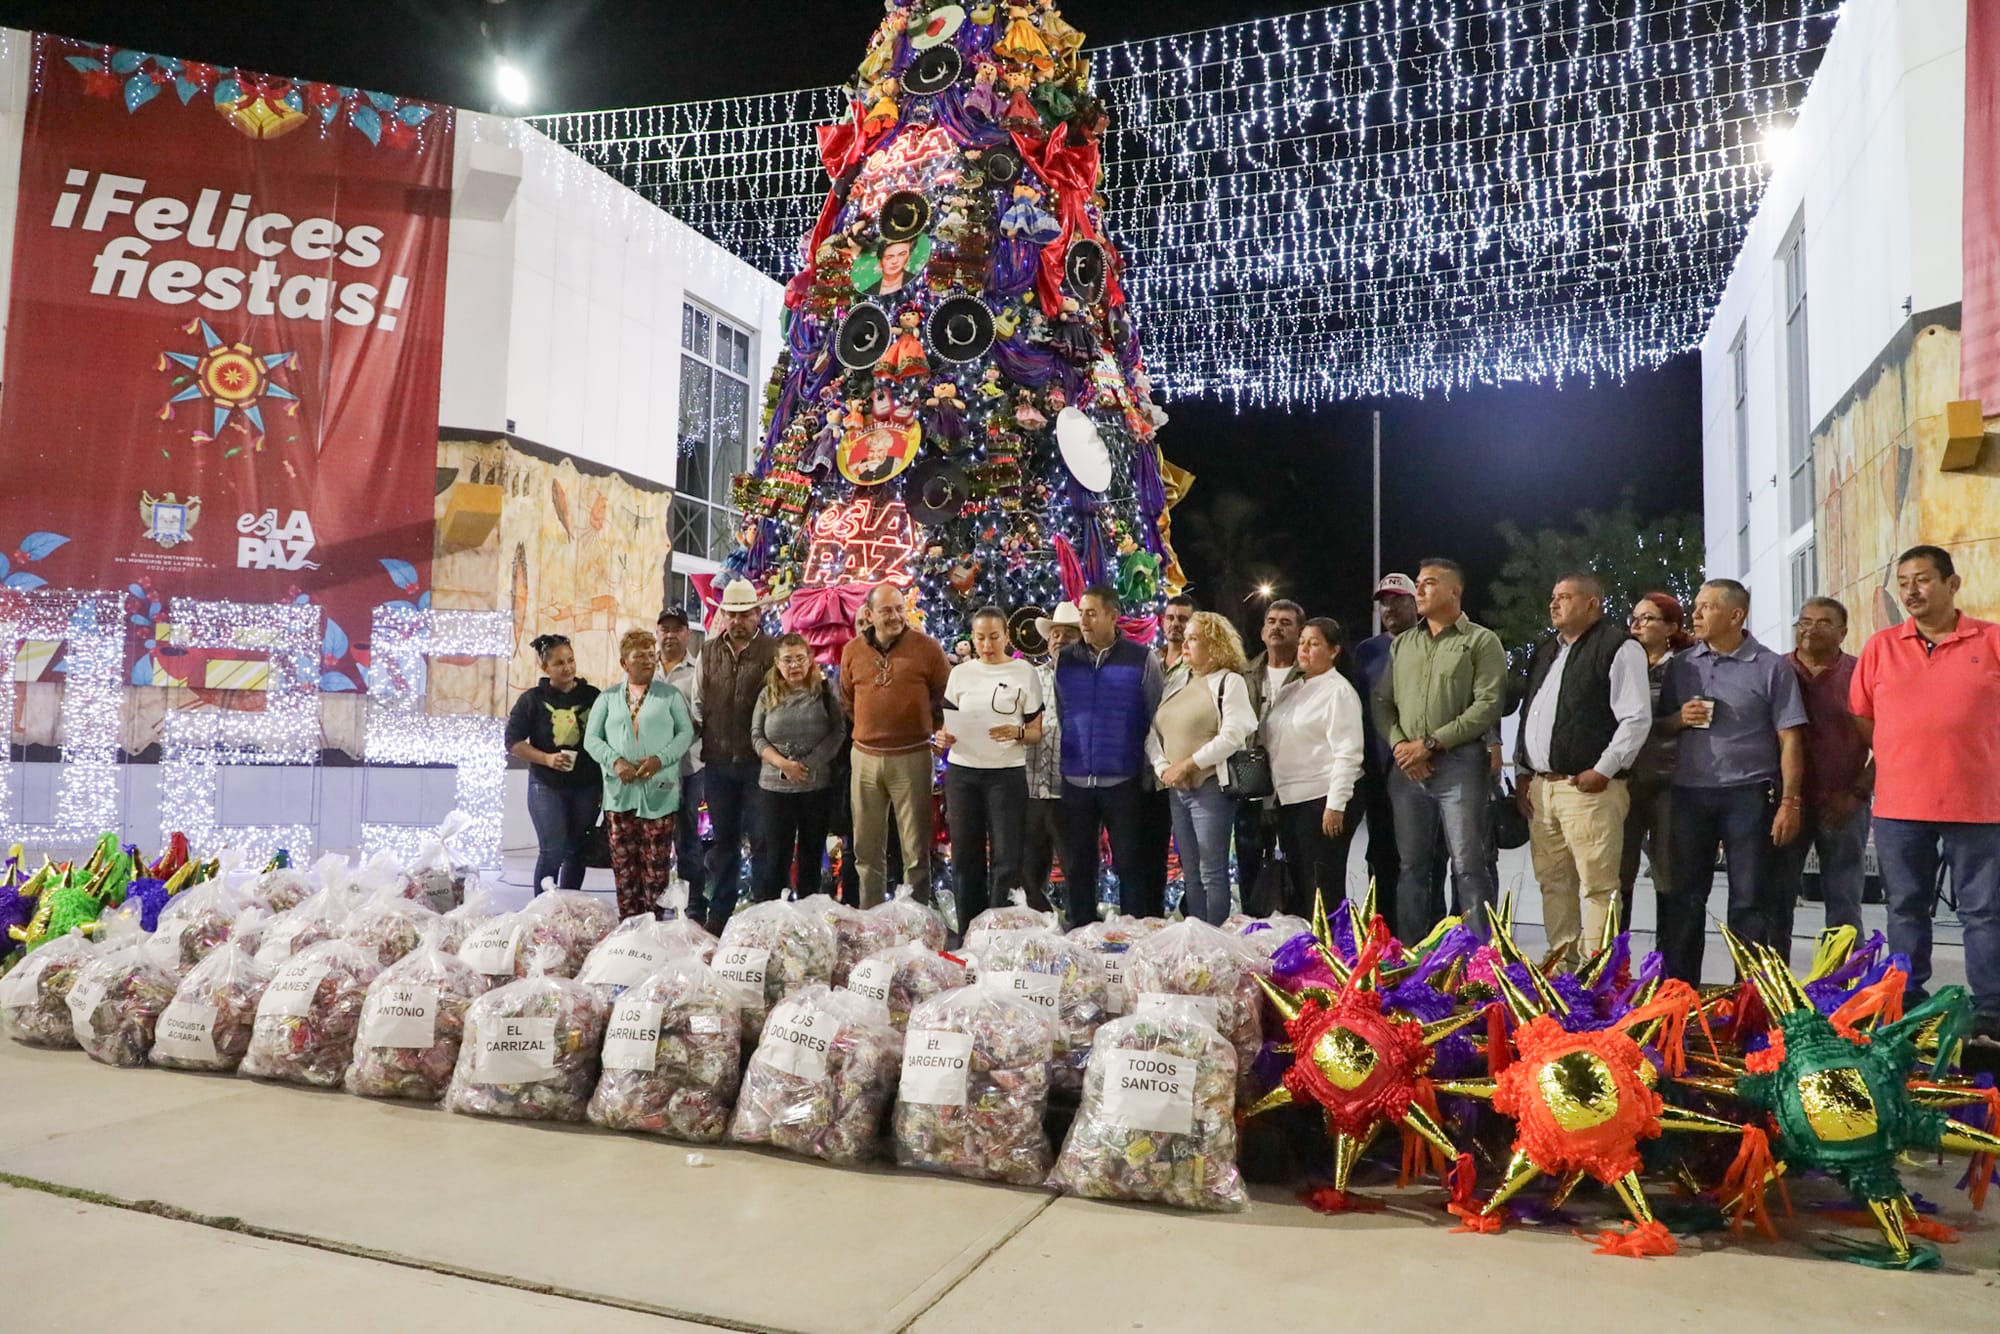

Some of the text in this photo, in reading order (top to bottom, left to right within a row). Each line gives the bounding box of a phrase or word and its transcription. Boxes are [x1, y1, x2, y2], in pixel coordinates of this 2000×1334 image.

[50, 168, 385, 268] ¡Felices
[90, 235, 409, 332] fiestas!
[236, 536, 316, 571] PAZ
[803, 539, 913, 585] PAZ
[627, 950, 653, 962] BLAS
[725, 953, 747, 965] LOS
[1105, 960, 1120, 970] EL
[285, 967, 308, 977] LOS
[717, 970, 762, 983] RRILES
[1014, 979, 1029, 990] EL
[392, 991, 413, 1002] SAN
[377, 1005, 425, 1018] ANTONIO
[620, 1009, 641, 1022] LOS
[166, 1018, 206, 1032] CONQUISTA
[506, 1025, 523, 1036] EL
[167, 1031, 201, 1042] AGRARIA
[769, 1025, 827, 1053] DOLORES
[486, 1040, 546, 1052] CARRIZAL
[927, 1039, 941, 1050] EL
[1128, 1059, 1177, 1076] TODOS
[1120, 1076, 1179, 1095] SANTOS
